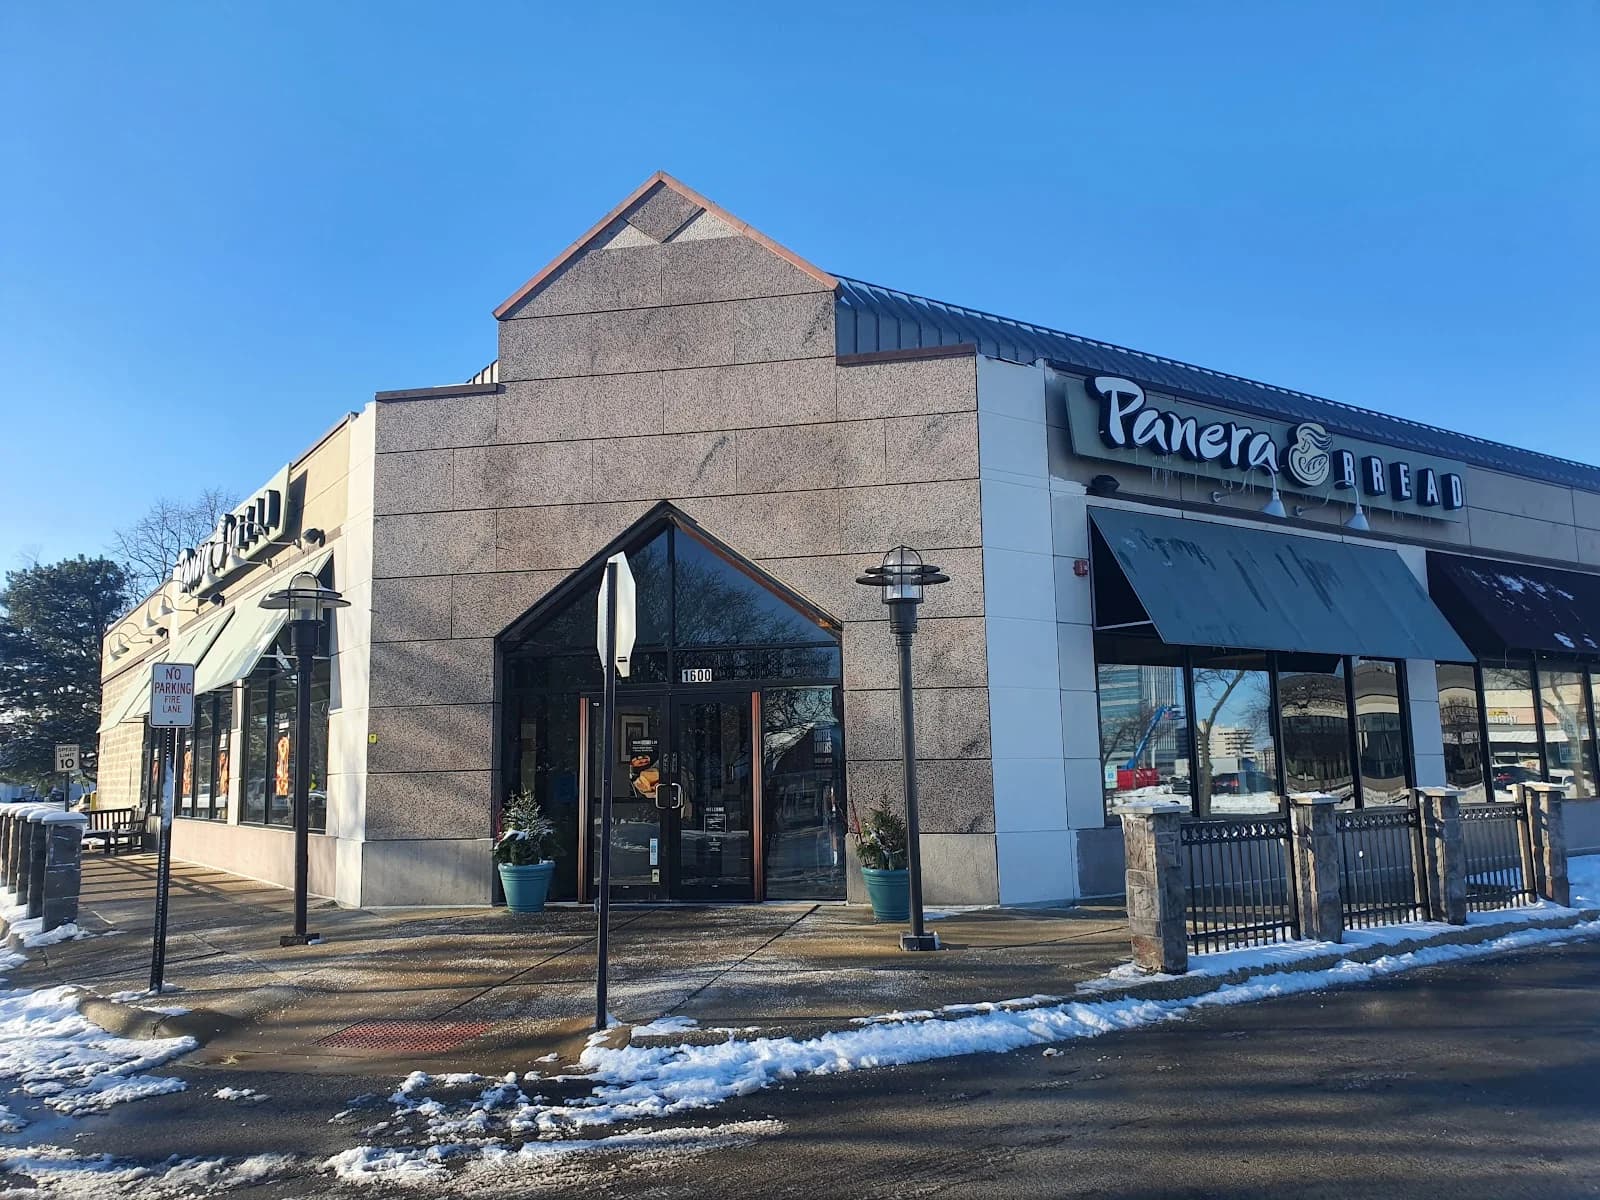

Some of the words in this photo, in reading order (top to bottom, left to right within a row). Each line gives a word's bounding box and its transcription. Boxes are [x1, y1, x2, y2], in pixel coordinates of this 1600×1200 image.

[1095, 376, 1279, 473] Panera
[1342, 449, 1463, 508] BREAD
[165, 668, 182, 680] NO
[683, 669, 711, 682] 1600
[154, 681, 192, 694] PARKING
[164, 695, 181, 704] FIRE
[162, 704, 183, 713] LANE
[60, 758, 75, 769] 10
